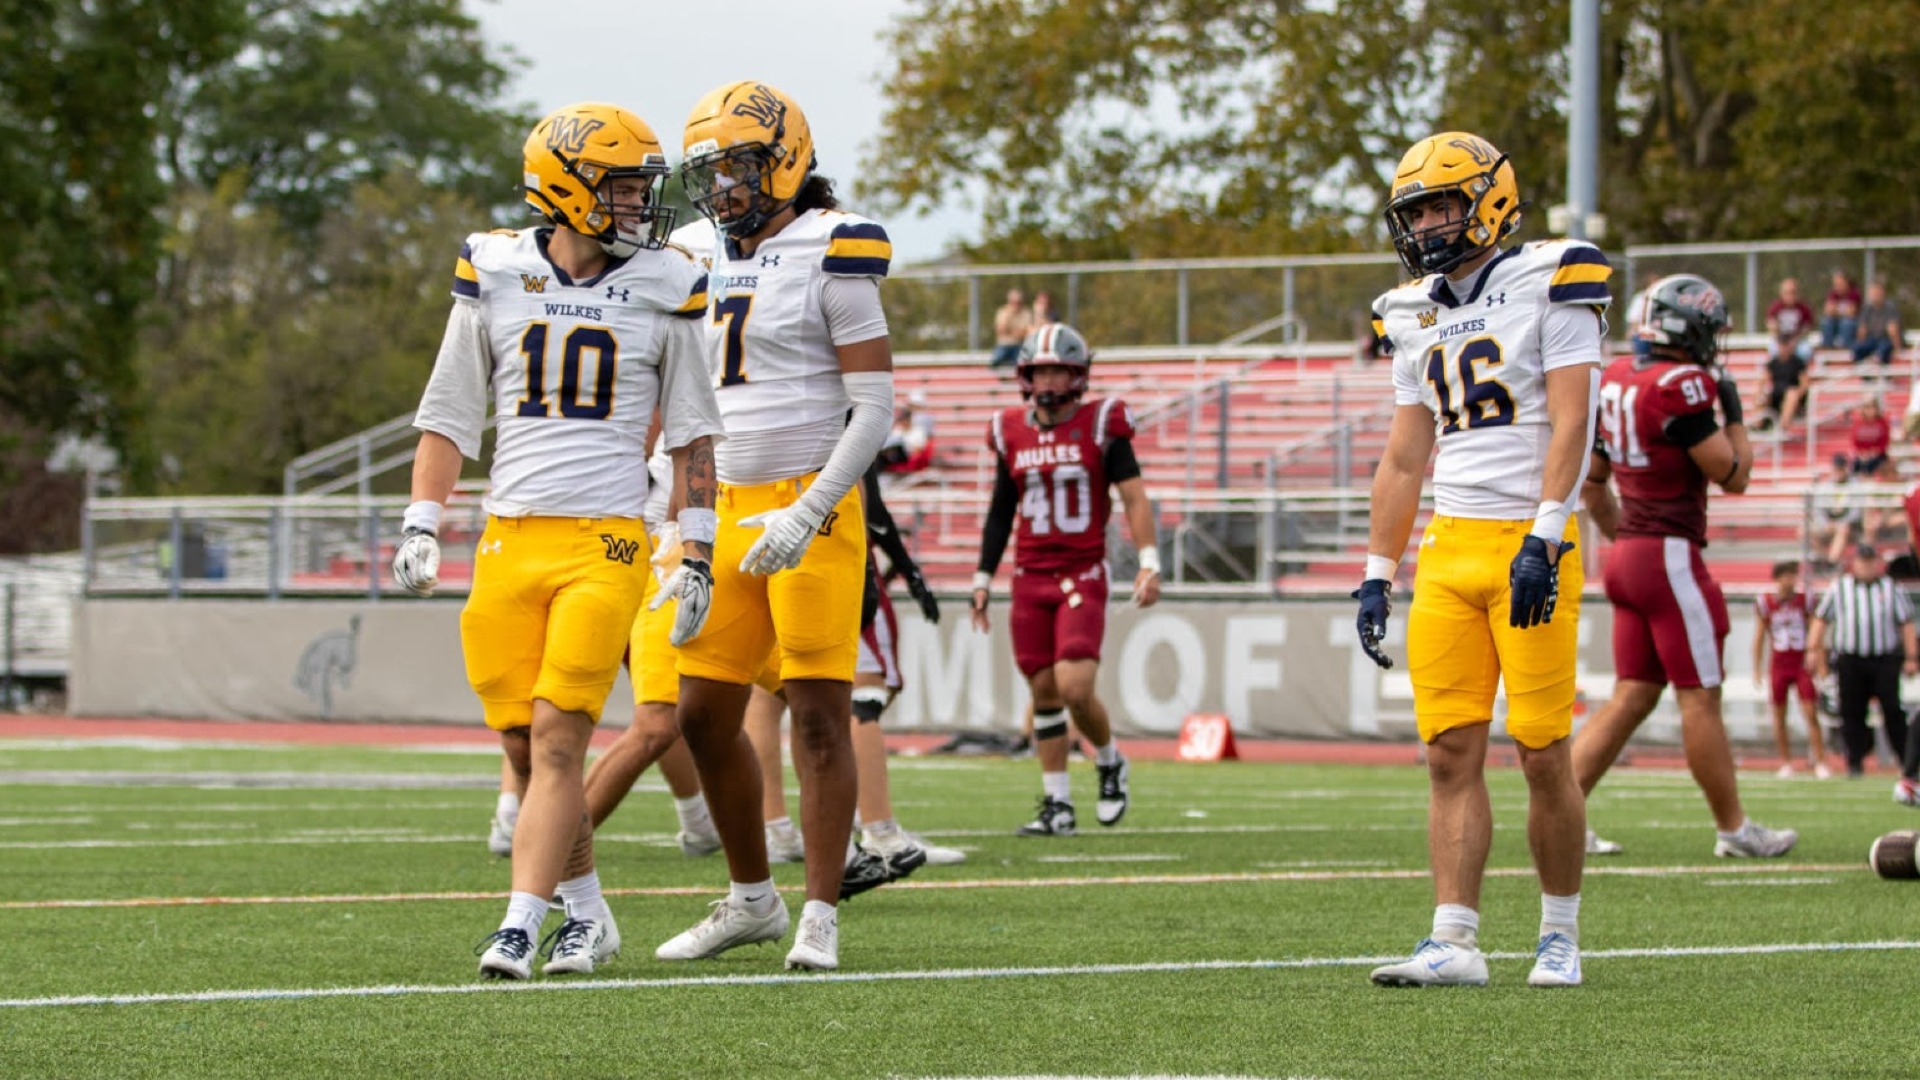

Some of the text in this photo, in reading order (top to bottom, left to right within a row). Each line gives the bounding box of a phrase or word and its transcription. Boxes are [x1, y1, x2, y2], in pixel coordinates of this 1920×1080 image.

[732, 84, 786, 128] W
[546, 116, 605, 153] W
[521, 273, 549, 293] W
[724, 275, 759, 289] LKES
[545, 303, 603, 321] WILKES
[1416, 306, 1439, 329] W
[1439, 318, 1485, 340] WILKES
[713, 293, 755, 387] 7
[516, 319, 620, 421] 10
[1426, 333, 1518, 437] 16
[1681, 376, 1708, 405] 91
[1600, 382, 1650, 467] 91
[1014, 444, 1081, 469] MULES
[1022, 465, 1091, 535] 40
[600, 534, 639, 564] W
[1120, 615, 1287, 733] OF
[1180, 719, 1225, 759] 30
